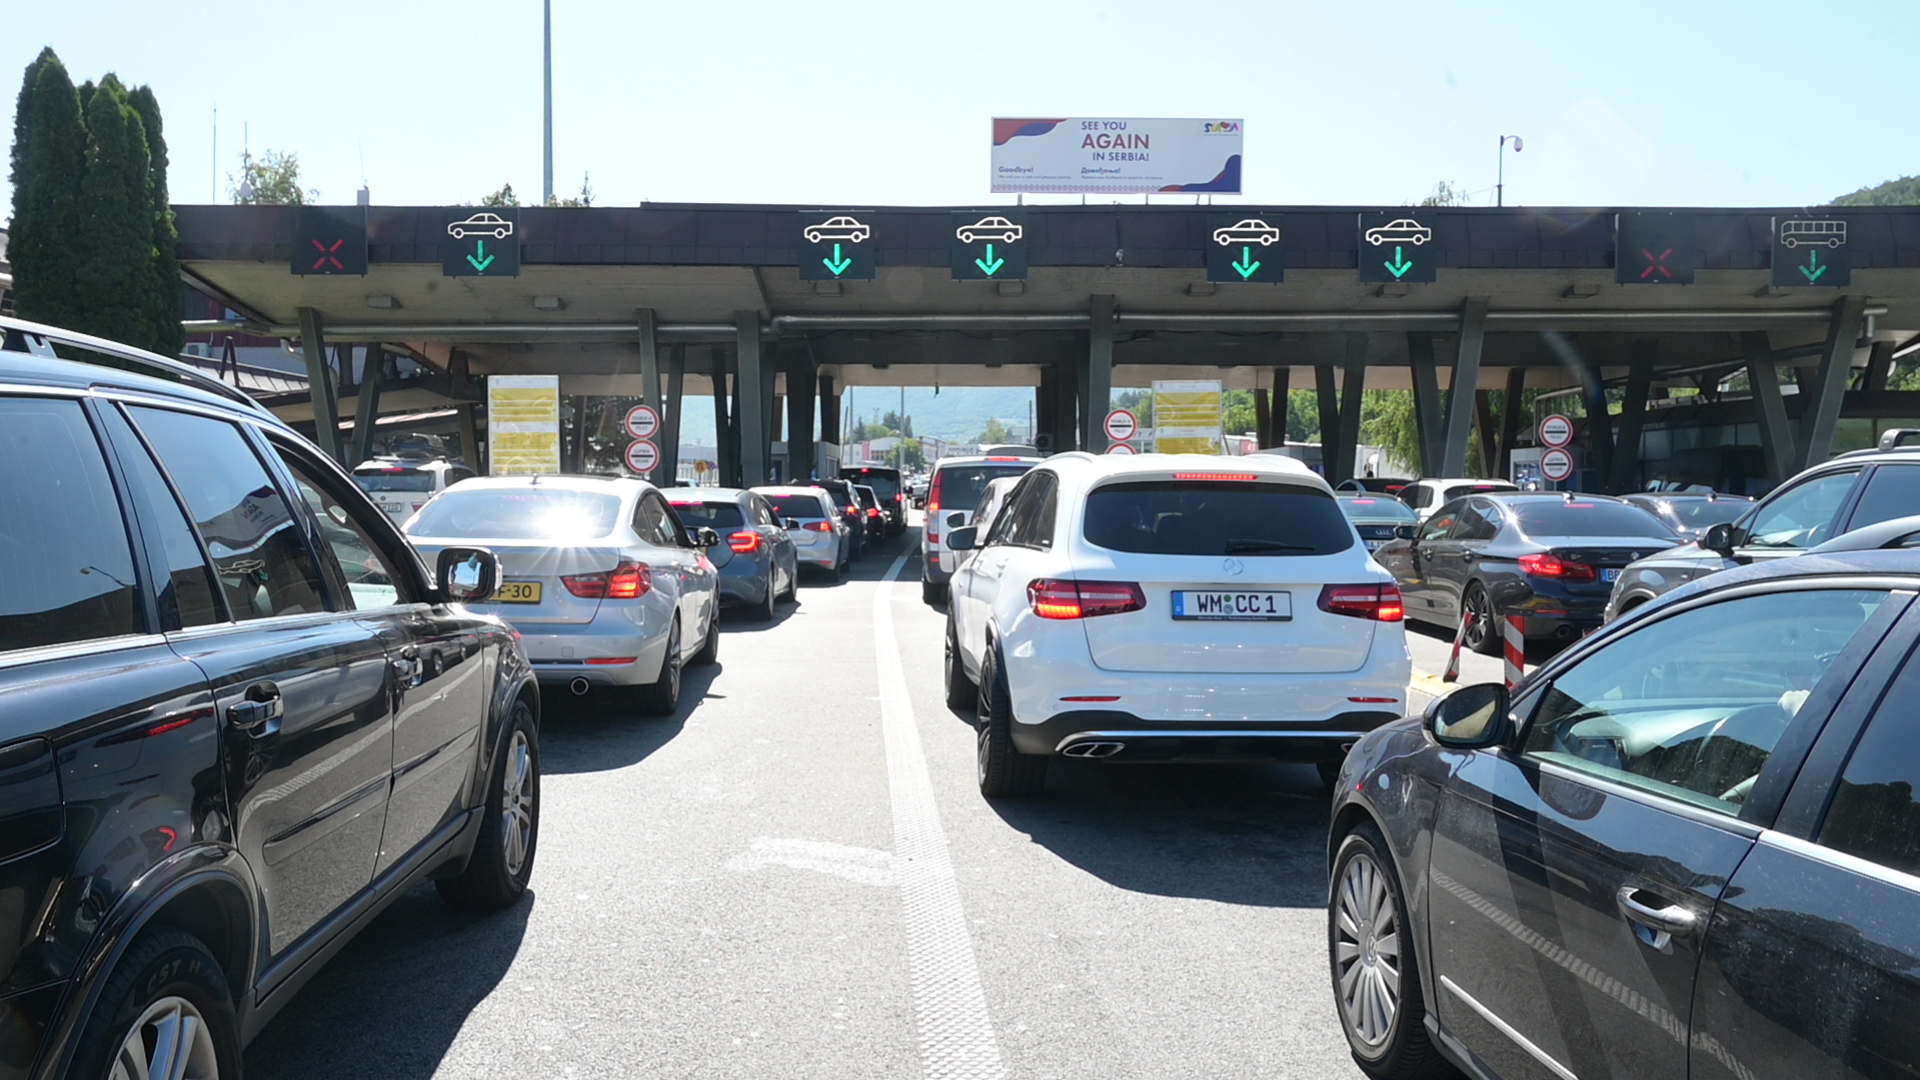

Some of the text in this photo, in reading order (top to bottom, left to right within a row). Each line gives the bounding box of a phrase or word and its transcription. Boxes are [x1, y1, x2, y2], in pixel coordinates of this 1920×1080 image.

[1081, 121, 1127, 130] SEE YOU
[1081, 133, 1149, 149] AGAIN
[1092, 152, 1149, 161] IN SERBIA!
[998, 166, 1034, 174] Goodbye!
[1197, 594, 1222, 613] WM
